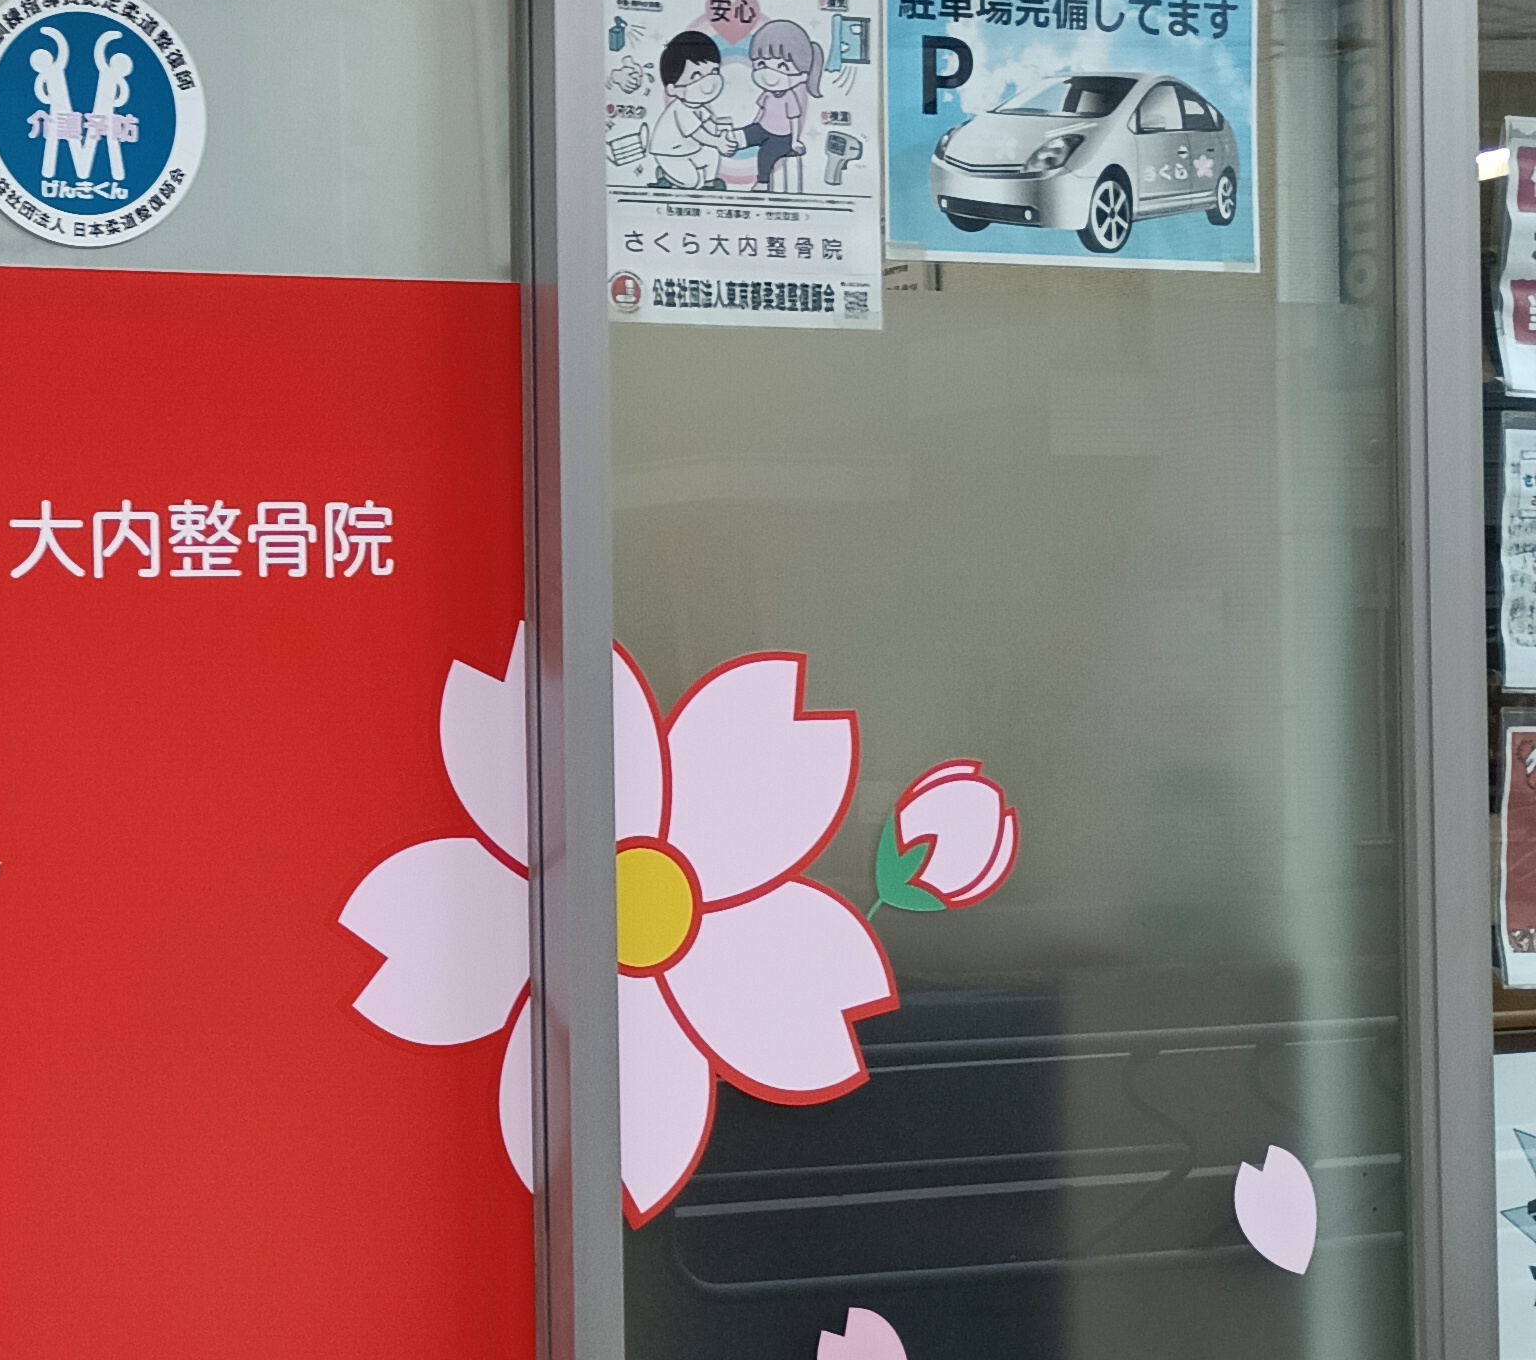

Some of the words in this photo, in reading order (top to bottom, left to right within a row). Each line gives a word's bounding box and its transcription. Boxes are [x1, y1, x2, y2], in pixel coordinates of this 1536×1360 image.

[922, 35, 974, 115] P
[27, 110, 140, 143] 介護予防
[41, 179, 129, 200] げんきくん
[624, 230, 843, 261] さくら大内整骨院
